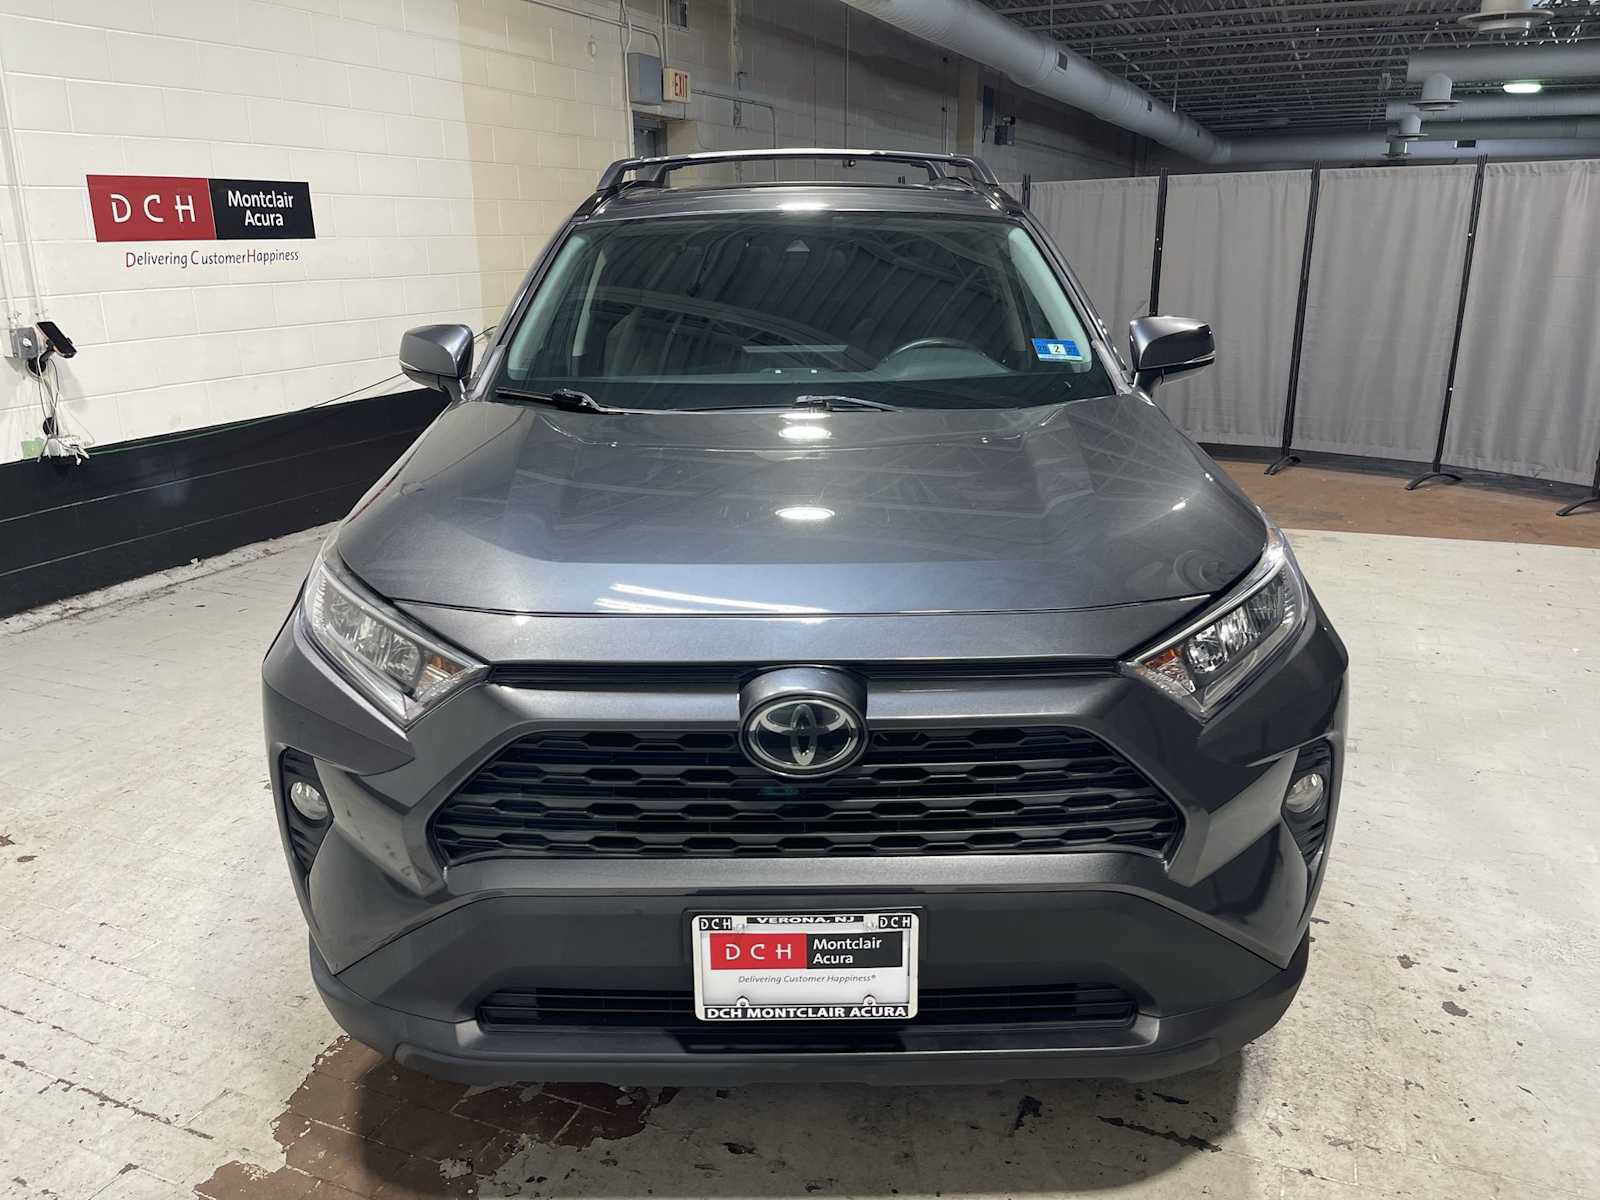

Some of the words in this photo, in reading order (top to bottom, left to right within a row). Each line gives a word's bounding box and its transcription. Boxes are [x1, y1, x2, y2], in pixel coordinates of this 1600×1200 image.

[674, 71, 688, 97] EXIT
[227, 190, 294, 208] Montclair
[110, 193, 196, 223] DCH
[244, 210, 284, 227] Acura
[125, 250, 188, 269] Delivering
[190, 250, 246, 266] Customer
[247, 249, 299, 265] Happiness
[700, 918, 732, 930] DCH
[879, 916, 911, 928] DCH
[813, 937, 882, 950] Montclair
[725, 943, 792, 961] DCH
[812, 953, 854, 964] Acura
[738, 975, 782, 985] Delivering
[783, 974, 825, 983] Customer
[706, 1008, 742, 1018] DCH
[746, 1007, 845, 1018] MONTCLAIR
[849, 1006, 906, 1017] ACURA
